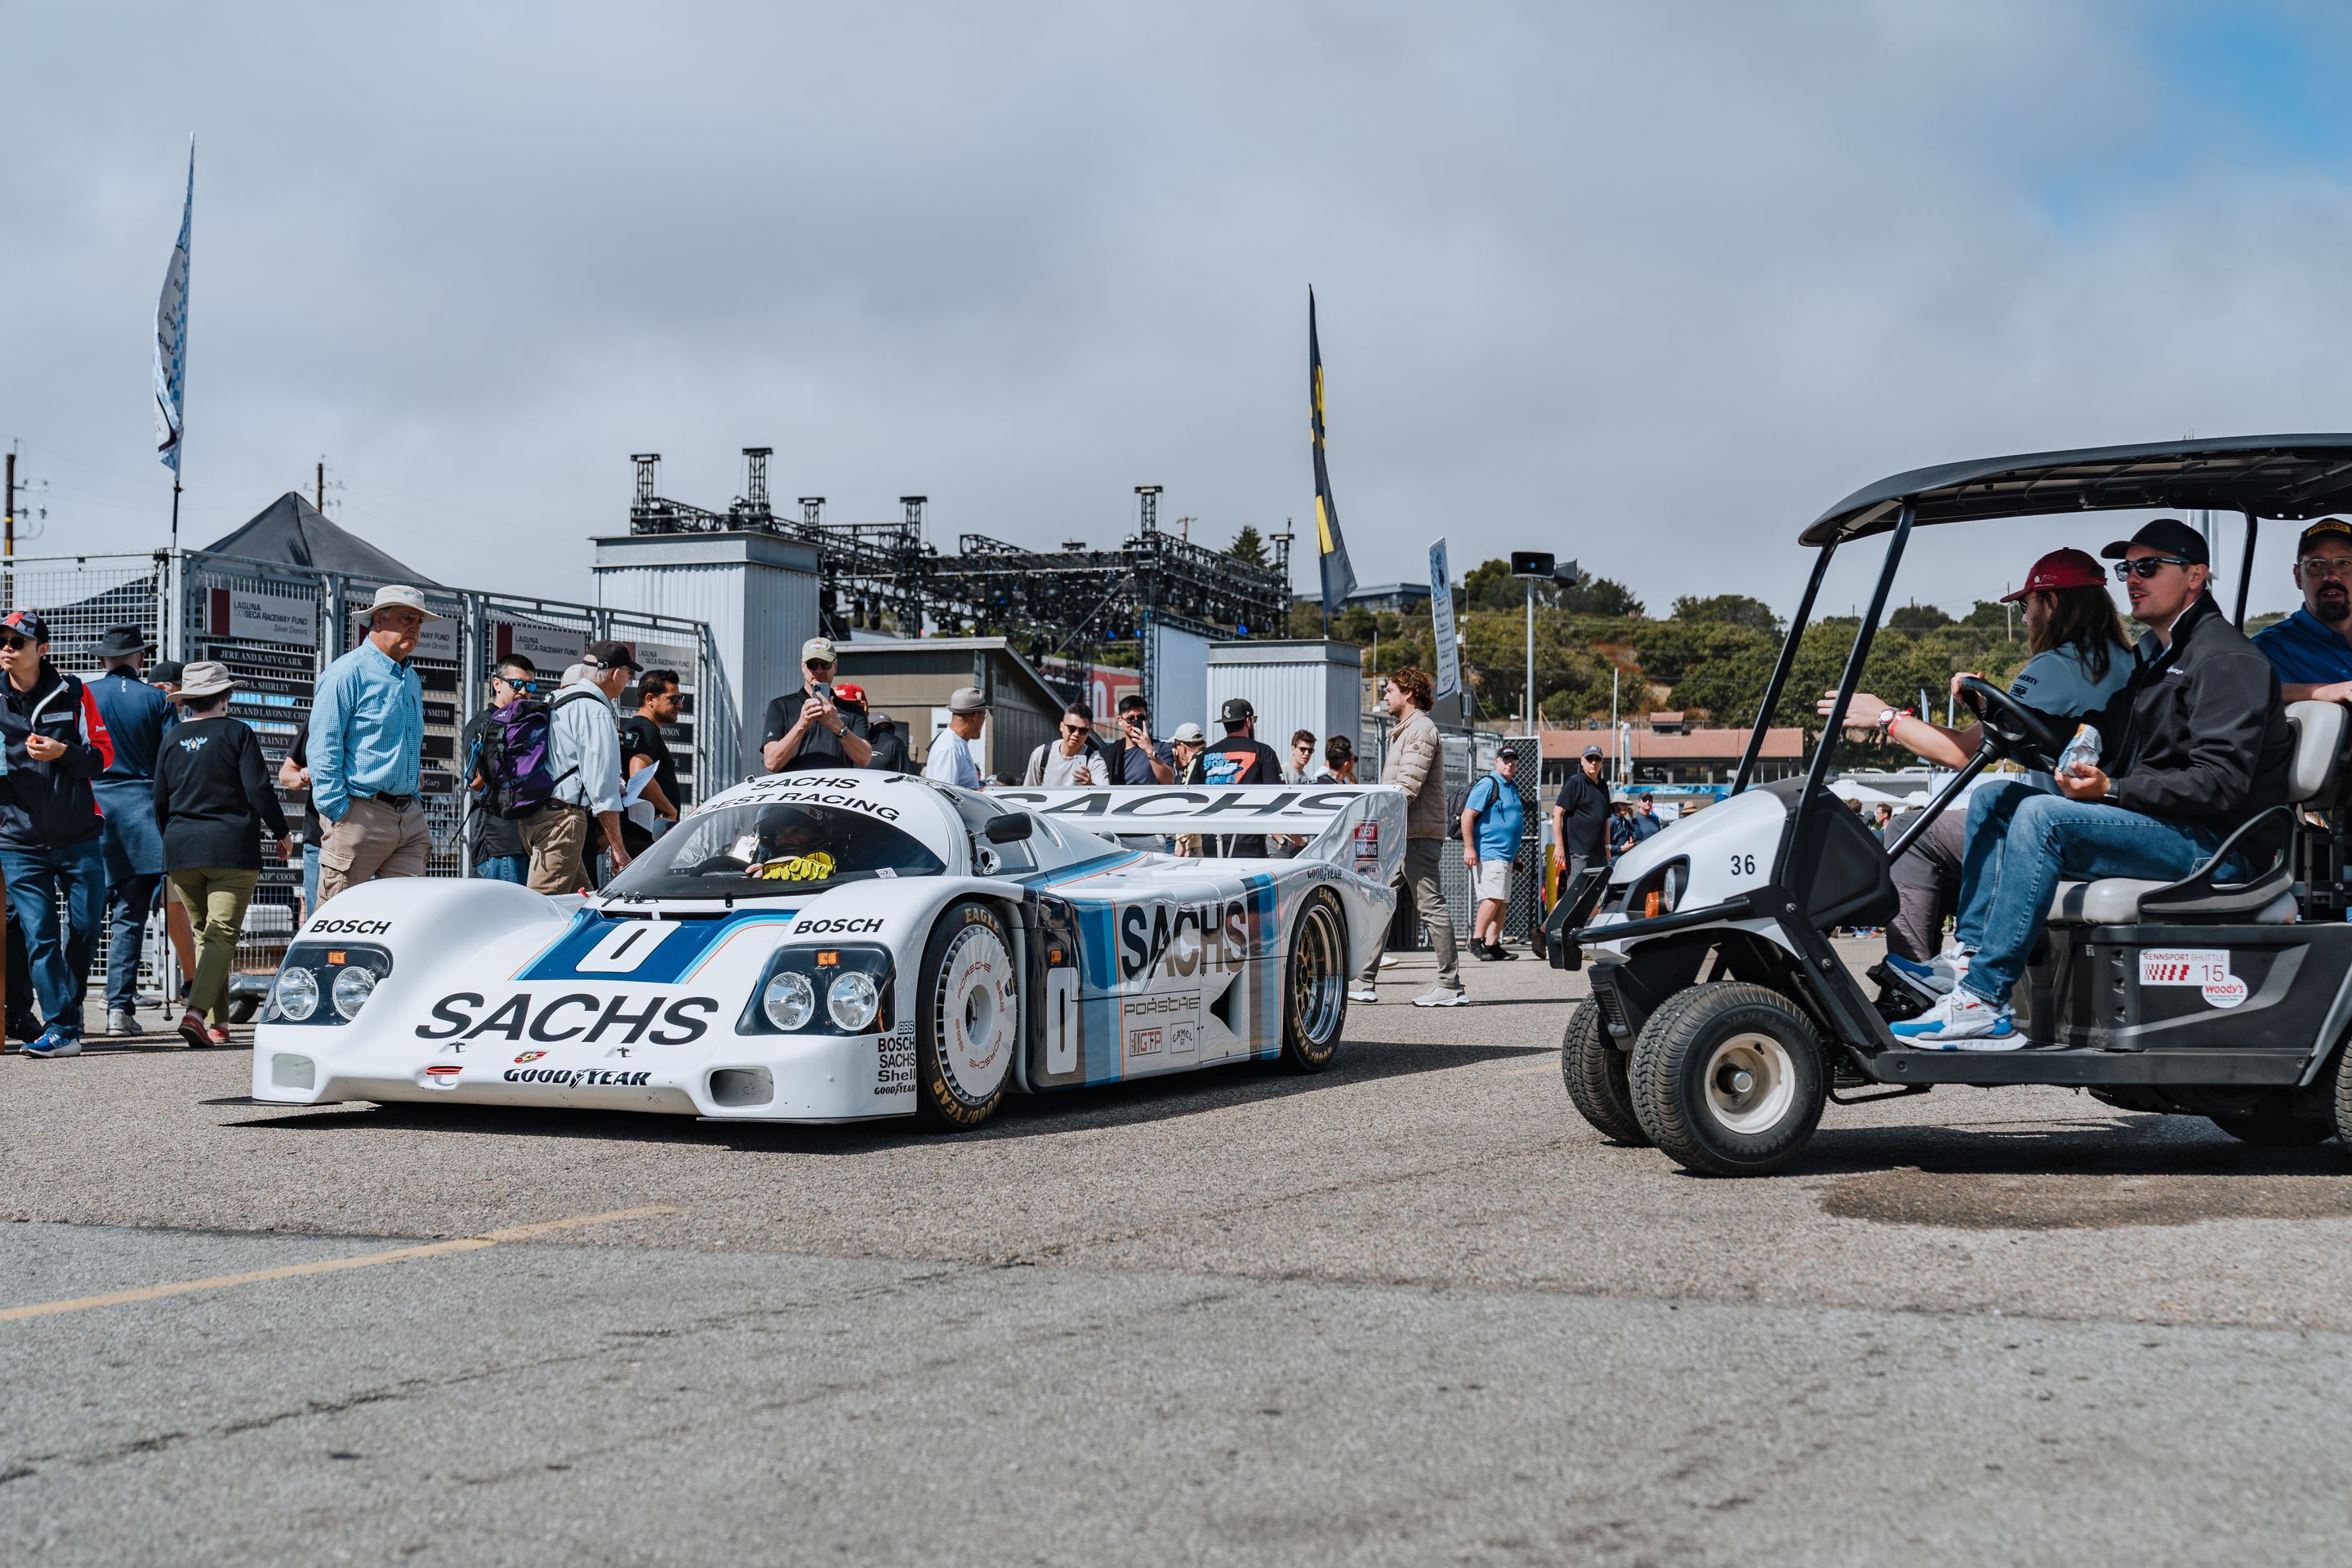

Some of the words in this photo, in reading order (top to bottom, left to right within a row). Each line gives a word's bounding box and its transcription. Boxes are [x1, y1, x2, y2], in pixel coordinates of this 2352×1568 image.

[234, 601, 261, 611] LAGUNA
[245, 611, 261, 620] SECA
[262, 612, 290, 623] RACEWAY
[292, 616, 308, 626] FUND
[274, 624, 288, 632] Silver
[289, 626, 308, 635] Donors
[432, 642, 449, 650] Donors
[515, 635, 539, 644] LAGUNA
[539, 645, 564, 653] RACEWAY
[564, 648, 578, 656] FUND
[220, 650, 238, 659] JERE
[242, 652, 257, 661] AND
[258, 653, 278, 663] KATY
[278, 655, 303, 666] CLARK
[658, 658, 678, 666] RACEWAY
[258, 681, 290, 692] SHIRLEY
[260, 710, 293, 719] LAVONNE
[428, 709, 449, 719] SMITH
[261, 736, 289, 746] RAINEY
[751, 776, 860, 791] SACHS
[777, 792, 900, 822] RACING
[993, 792, 1365, 817] SACHS
[1357, 826, 1374, 837] JOEST
[1356, 844, 1377, 856] RACING
[1731, 854, 1755, 875] 36
[276, 873, 296, 881] COOK
[1318, 887, 1340, 915] EAGLE
[309, 920, 392, 934] BOSCH
[793, 918, 884, 934] BOSCH
[965, 908, 1000, 933] EAGLE
[1121, 900, 1247, 982] SACHS
[2190, 954, 2225, 962] SHUTTLE
[957, 960, 991, 1000] PORSCHE
[2201, 965, 2225, 982] 15
[2205, 984, 2244, 994] Woody's
[1124, 997, 1200, 1016] PORSCHE
[415, 991, 719, 1045] SACHS
[898, 1021, 915, 1034] BBS
[1140, 1031, 1161, 1052] GTP
[1173, 1029, 1192, 1043] CAMEL
[878, 1036, 915, 1052] BOSCH
[969, 1029, 1003, 1070] PORSCHE
[879, 1052, 916, 1068] SACHS
[878, 1068, 916, 1082] Shell
